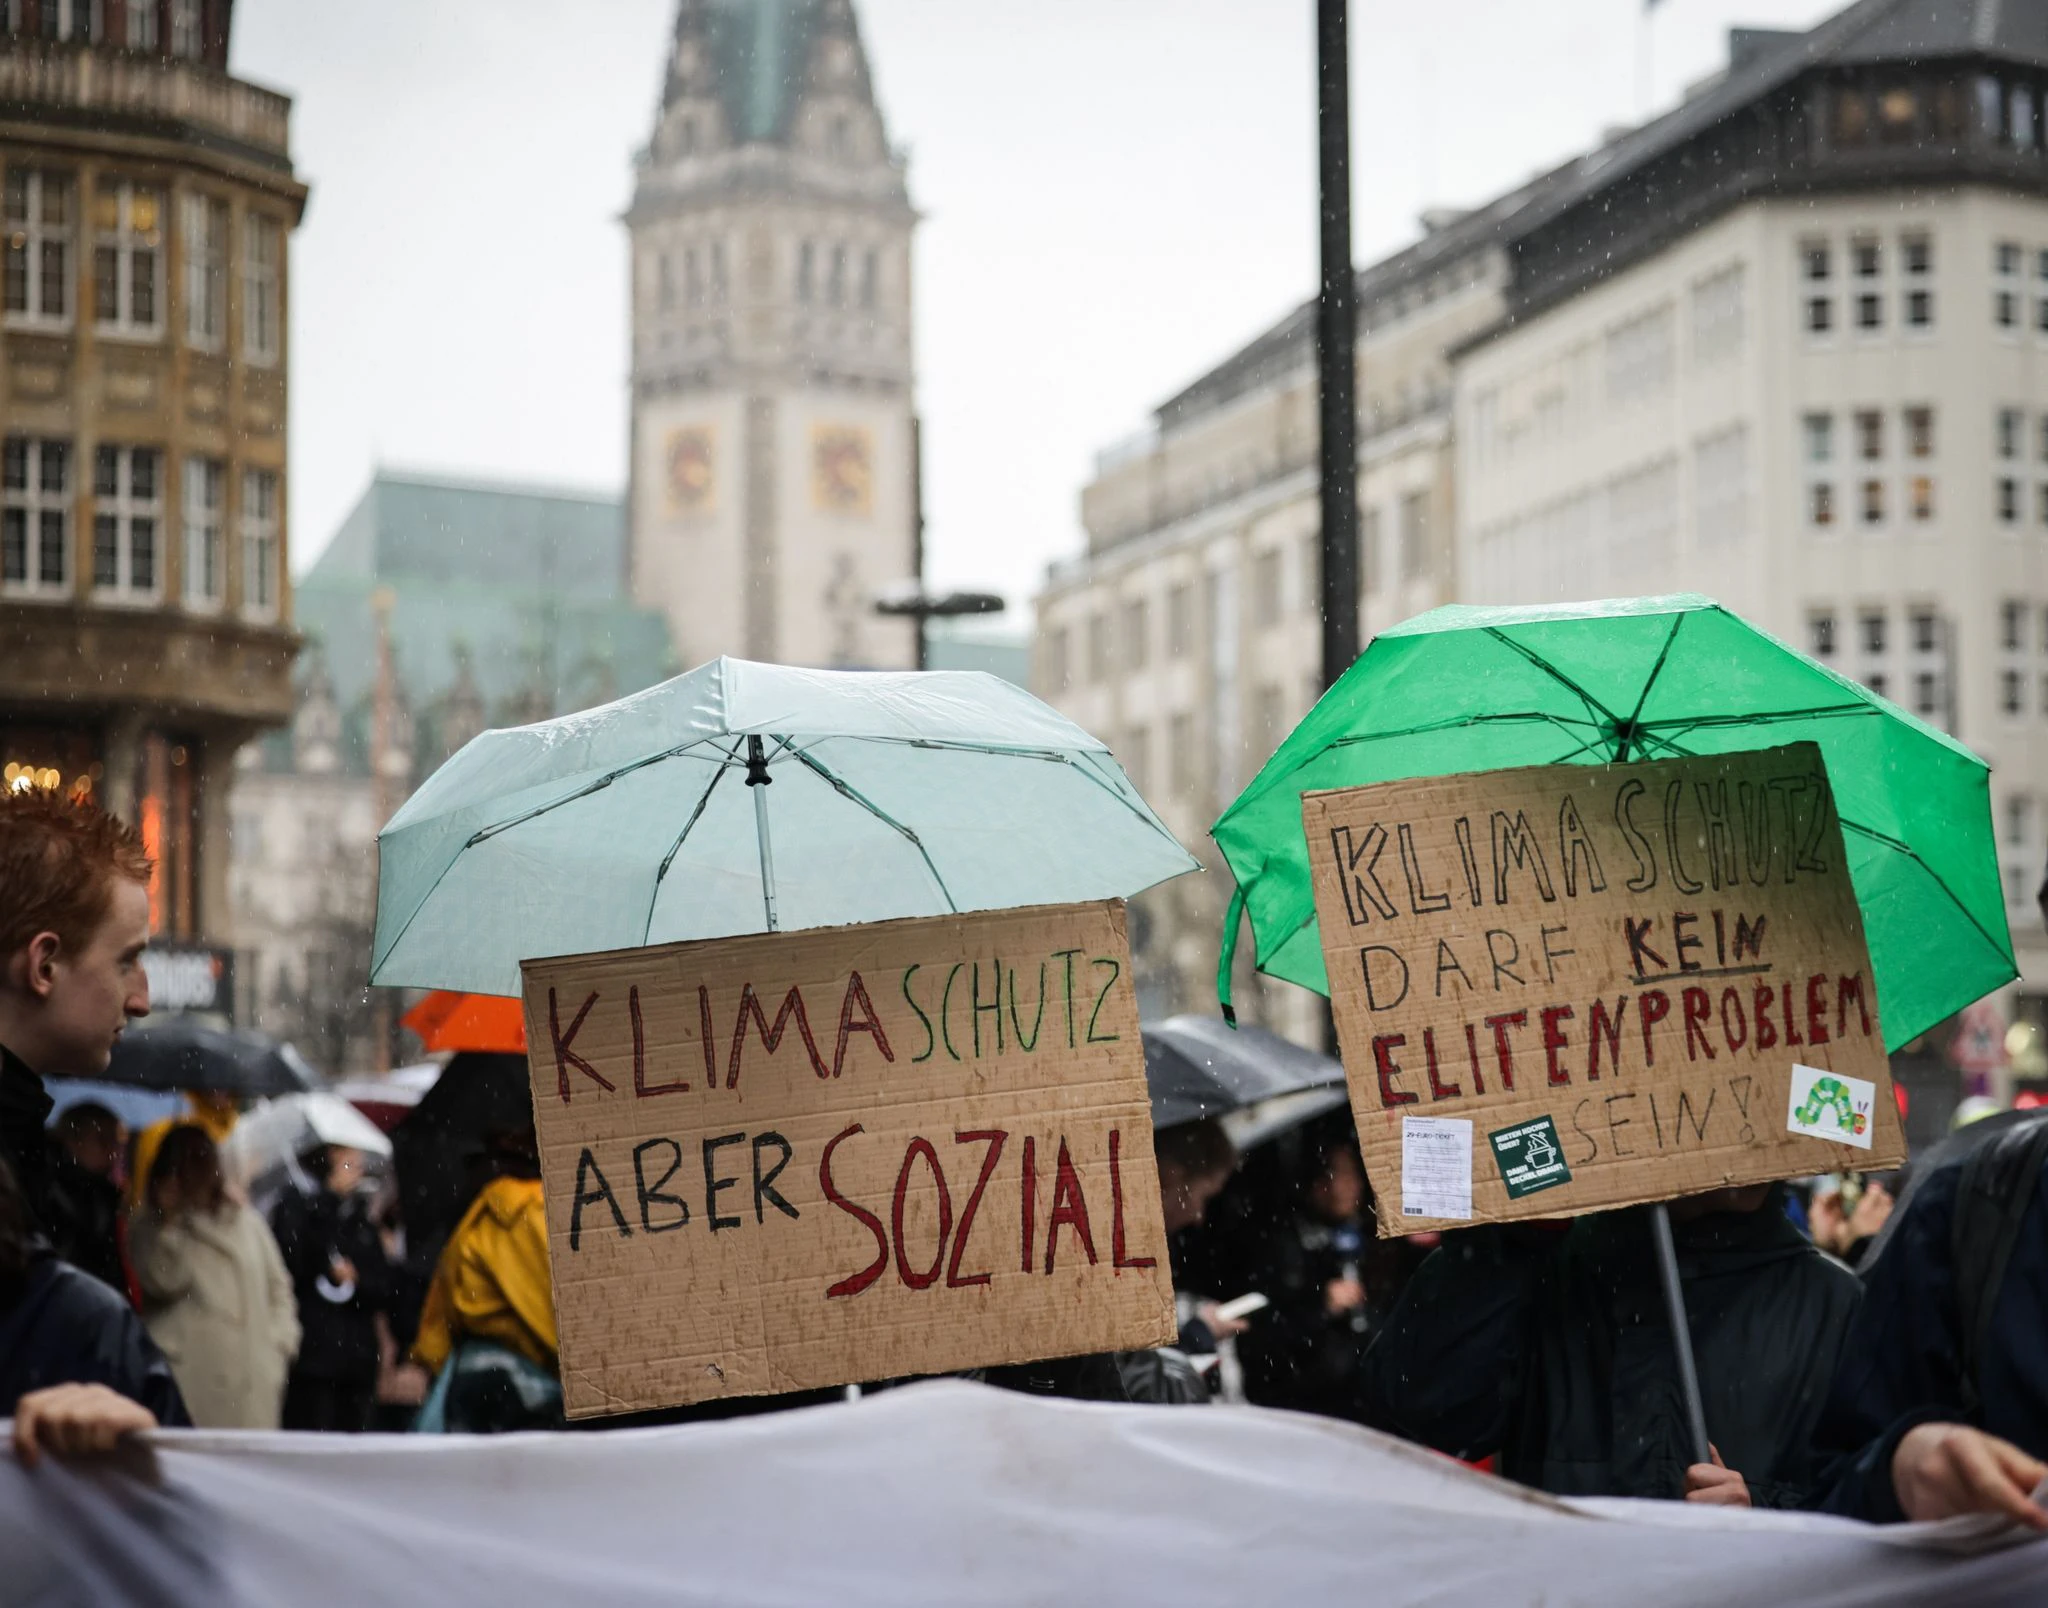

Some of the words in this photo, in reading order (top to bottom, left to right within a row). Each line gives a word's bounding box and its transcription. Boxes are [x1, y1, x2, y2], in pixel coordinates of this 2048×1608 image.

[1332, 773, 1831, 926] KLIMASCHUTZ
[547, 948, 1120, 1102] KLIMASCHUTZ
[1361, 923, 1576, 1012] DARF
[1624, 909, 1767, 976] KEIN
[1371, 971, 1873, 1107] ELITENPROBLEM
[1573, 1075, 1756, 1165] SEIN!
[570, 1130, 801, 1252] ABER
[818, 1123, 1157, 1299] SOZIAL
